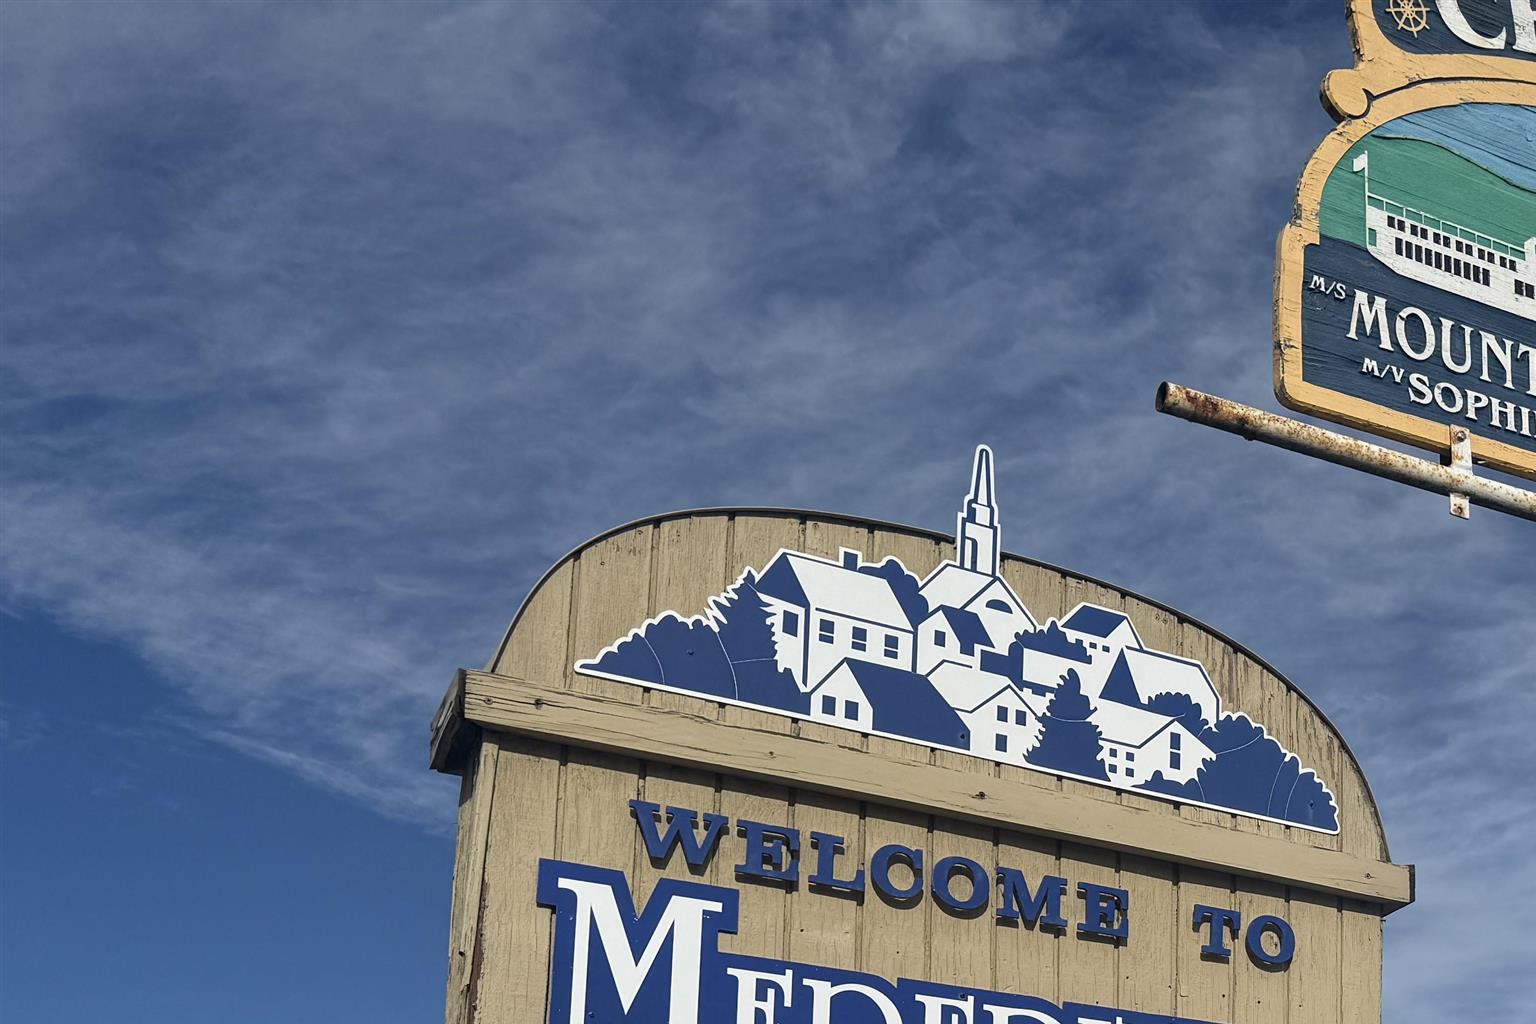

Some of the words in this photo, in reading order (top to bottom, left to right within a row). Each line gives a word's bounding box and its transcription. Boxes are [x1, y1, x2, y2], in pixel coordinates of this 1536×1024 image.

[1309, 274, 1347, 300] M/S
[1361, 357, 1405, 384] M/V
[629, 799, 1130, 945] WELCOME
[1192, 903, 1297, 972] TO
